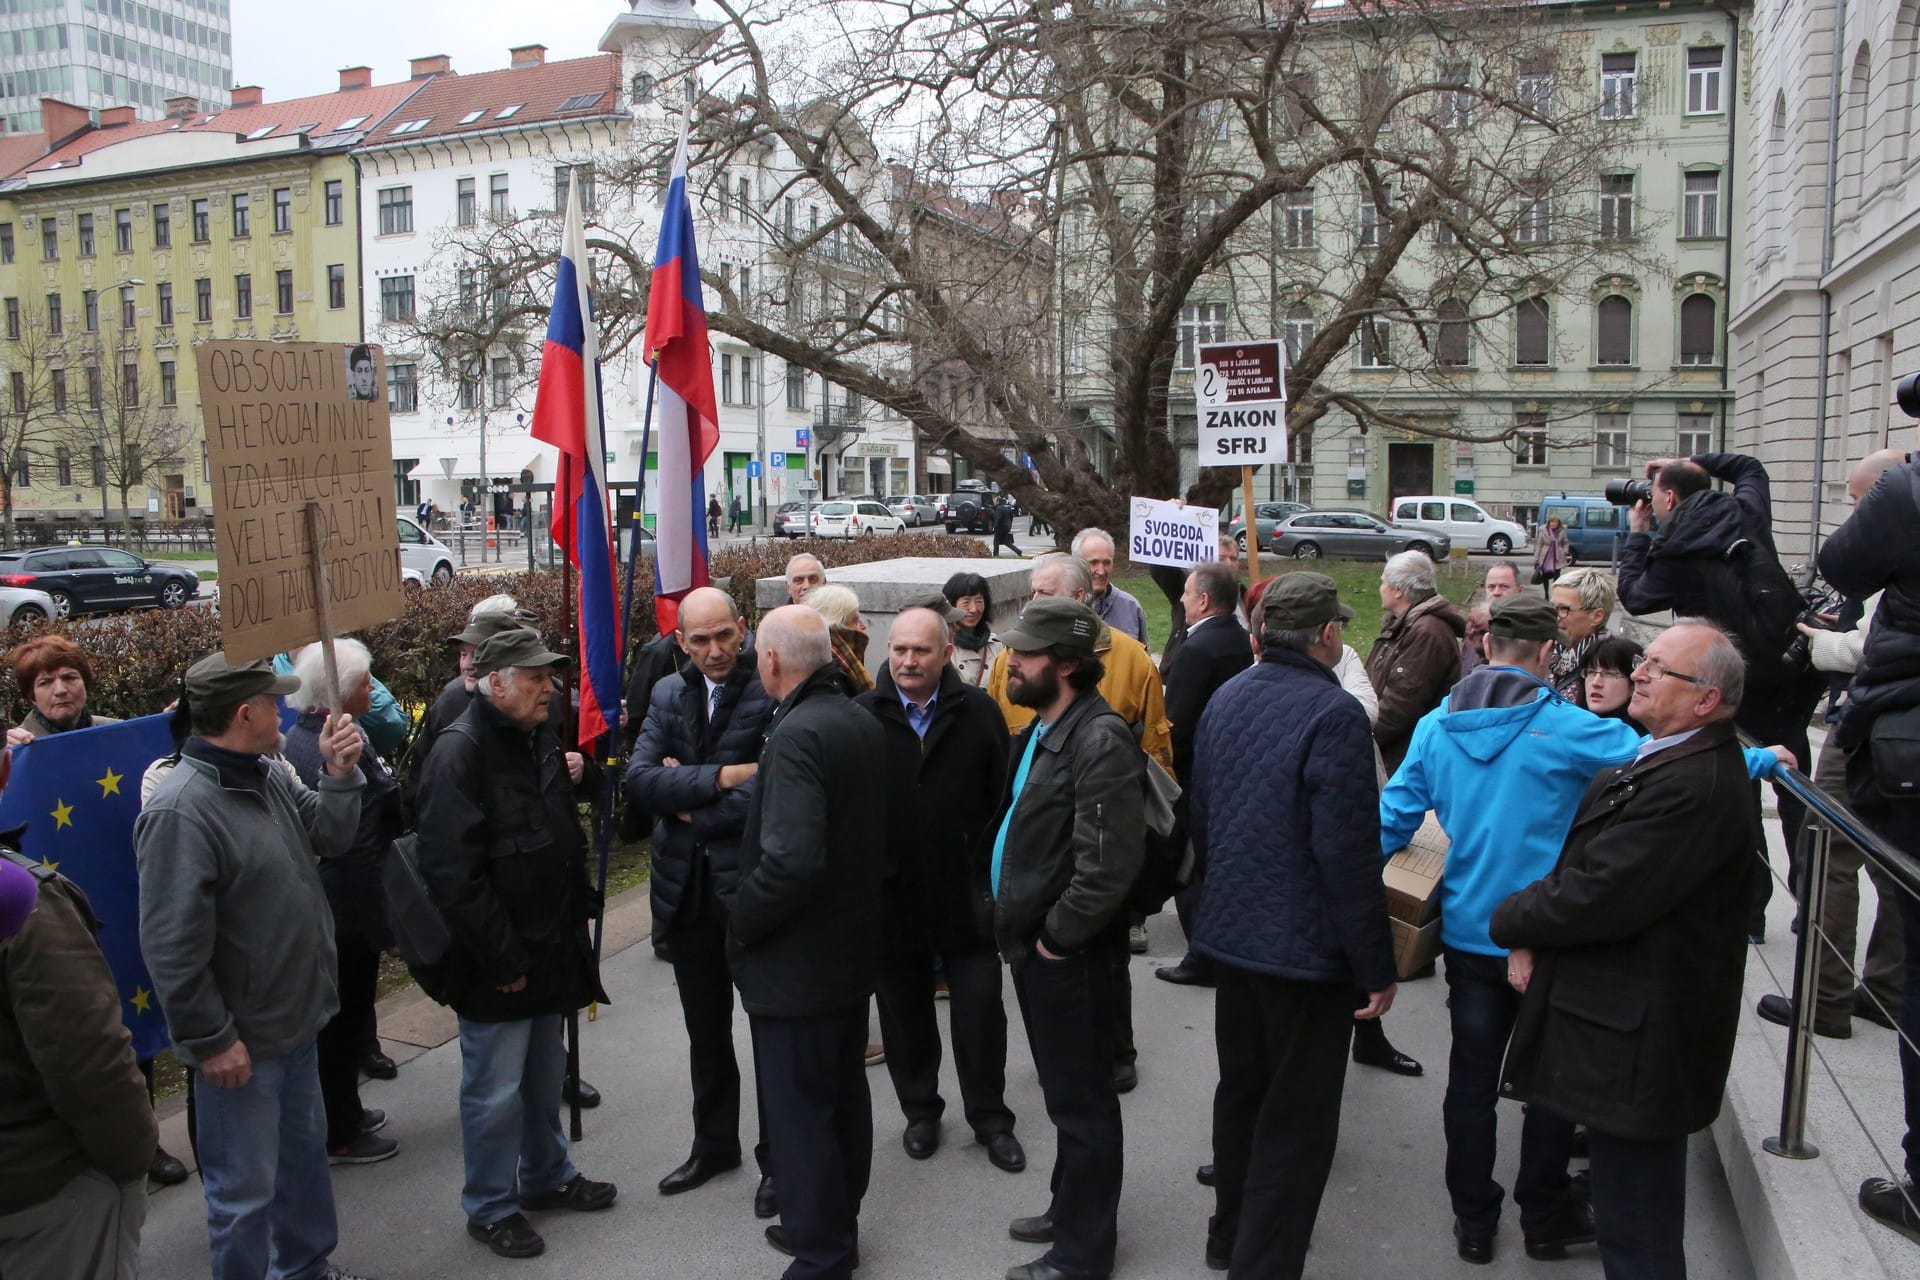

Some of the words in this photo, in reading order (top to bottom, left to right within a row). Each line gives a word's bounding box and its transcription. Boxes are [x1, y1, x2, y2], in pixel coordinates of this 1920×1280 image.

[210, 348, 336, 393] OBSOJATI
[328, 402, 347, 443] IN
[352, 400, 377, 441] NE
[1206, 410, 1276, 428] ZAKON
[1216, 437, 1267, 455] SFRJ
[222, 454, 343, 511] IZDAJALCA
[350, 449, 375, 494] JE
[1144, 519, 1204, 542] SVOBODA
[1133, 535, 1214, 562] SLOVENIJI
[230, 576, 273, 630] DOL
